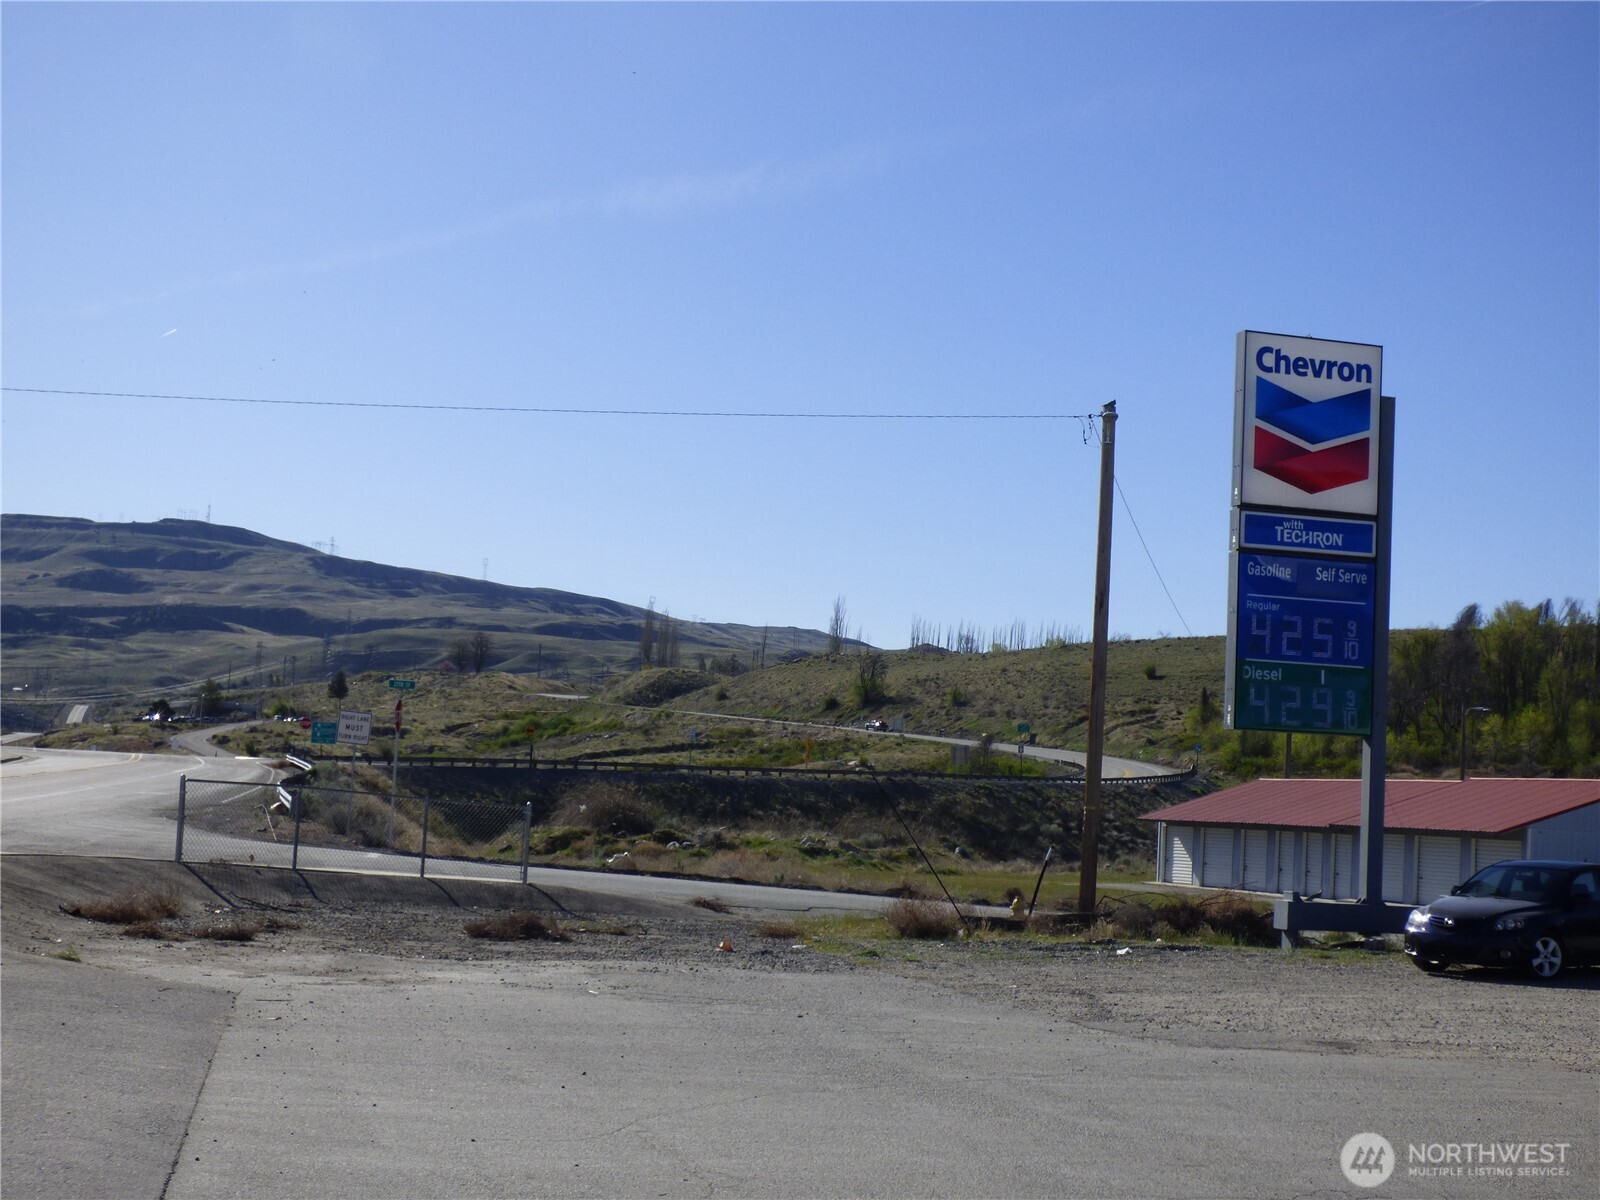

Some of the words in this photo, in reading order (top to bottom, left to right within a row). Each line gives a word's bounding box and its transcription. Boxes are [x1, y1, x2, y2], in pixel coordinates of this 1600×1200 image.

[1256, 346, 1372, 384] Chevron
[1283, 520, 1304, 530] with
[1275, 526, 1343, 548] TECHRON
[1247, 562, 1292, 579] Gasoline
[1315, 567, 1336, 581] Self
[1338, 569, 1368, 584] Serve
[1246, 601, 1280, 612] Regular
[1251, 614, 1332, 658] 425
[1347, 621, 1357, 637] 9
[1343, 641, 1359, 660] 10
[1242, 665, 1282, 681] Diesel
[1249, 684, 1332, 727] 429
[345, 724, 363, 732] MUST
[1343, 710, 1358, 730] 10
